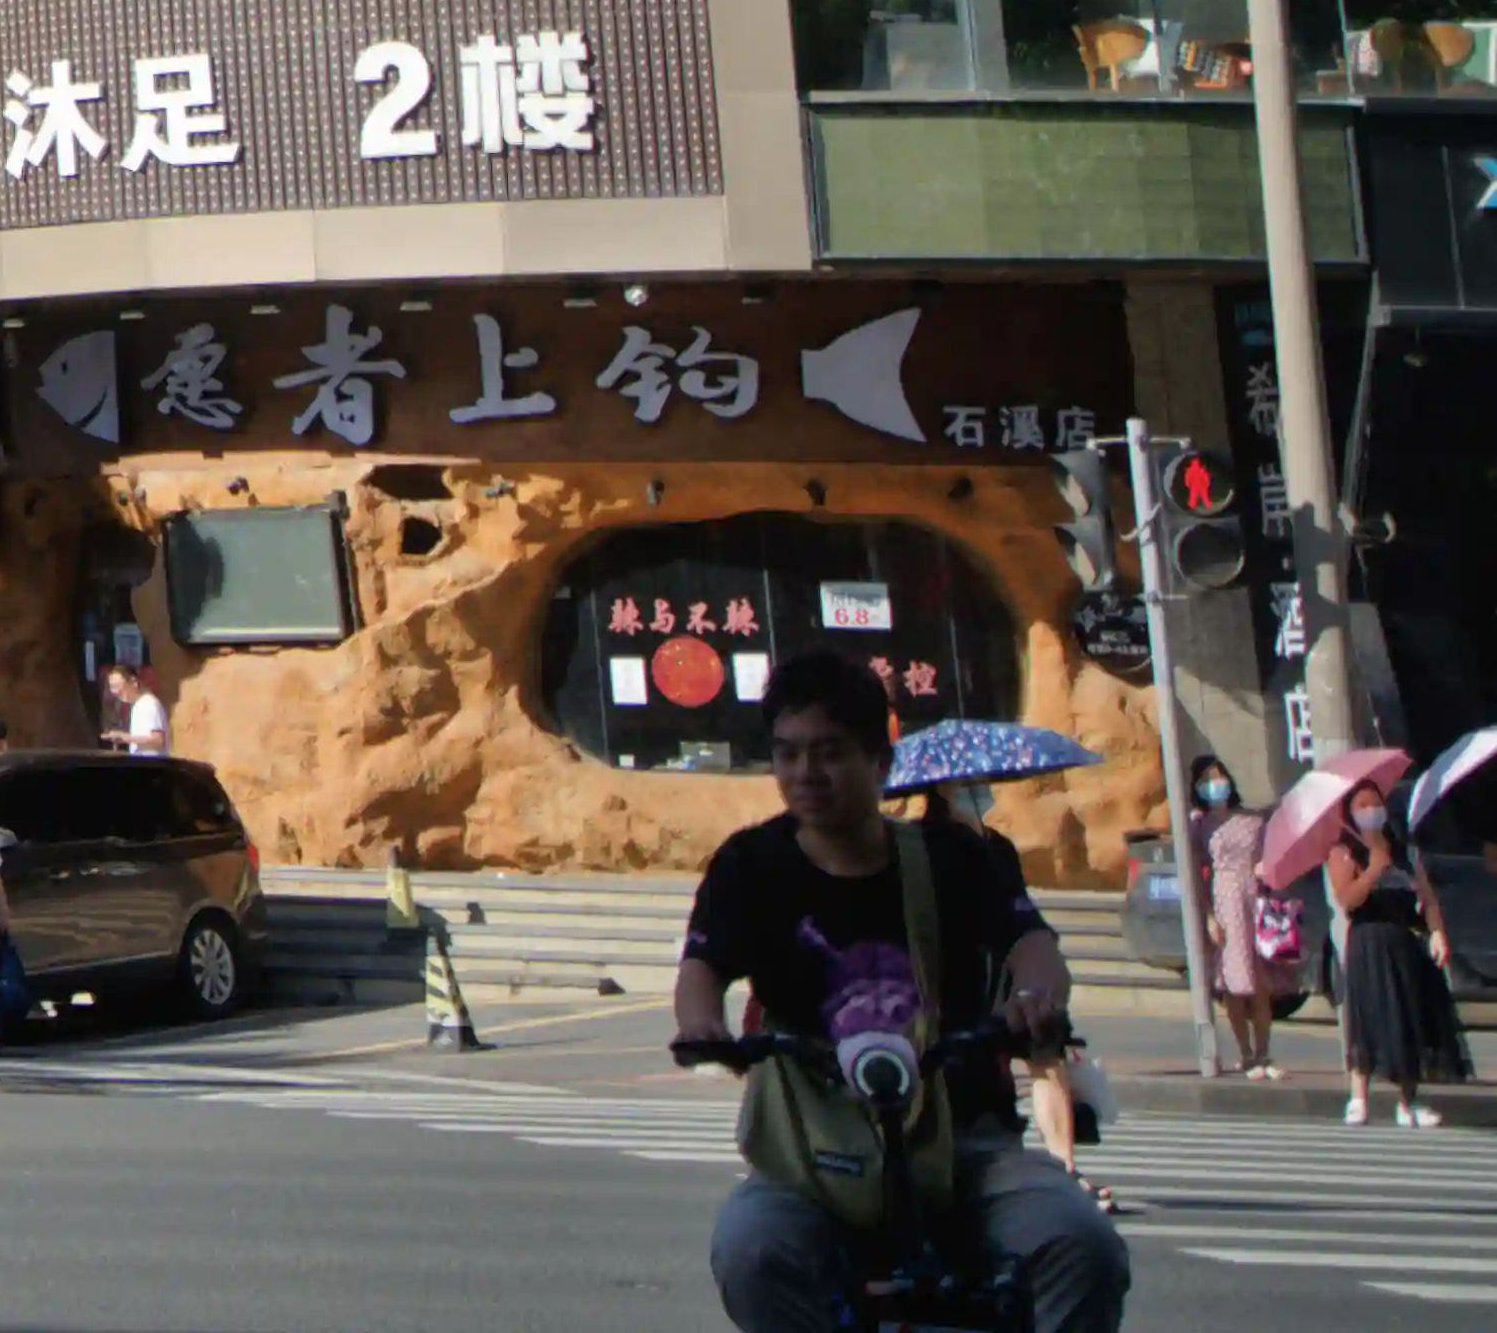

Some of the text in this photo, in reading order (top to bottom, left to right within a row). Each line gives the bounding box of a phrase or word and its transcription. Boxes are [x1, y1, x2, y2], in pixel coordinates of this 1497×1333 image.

[1, 29, 597, 180] 沐足 2楼
[941, 402, 1097, 452] 石溪店
